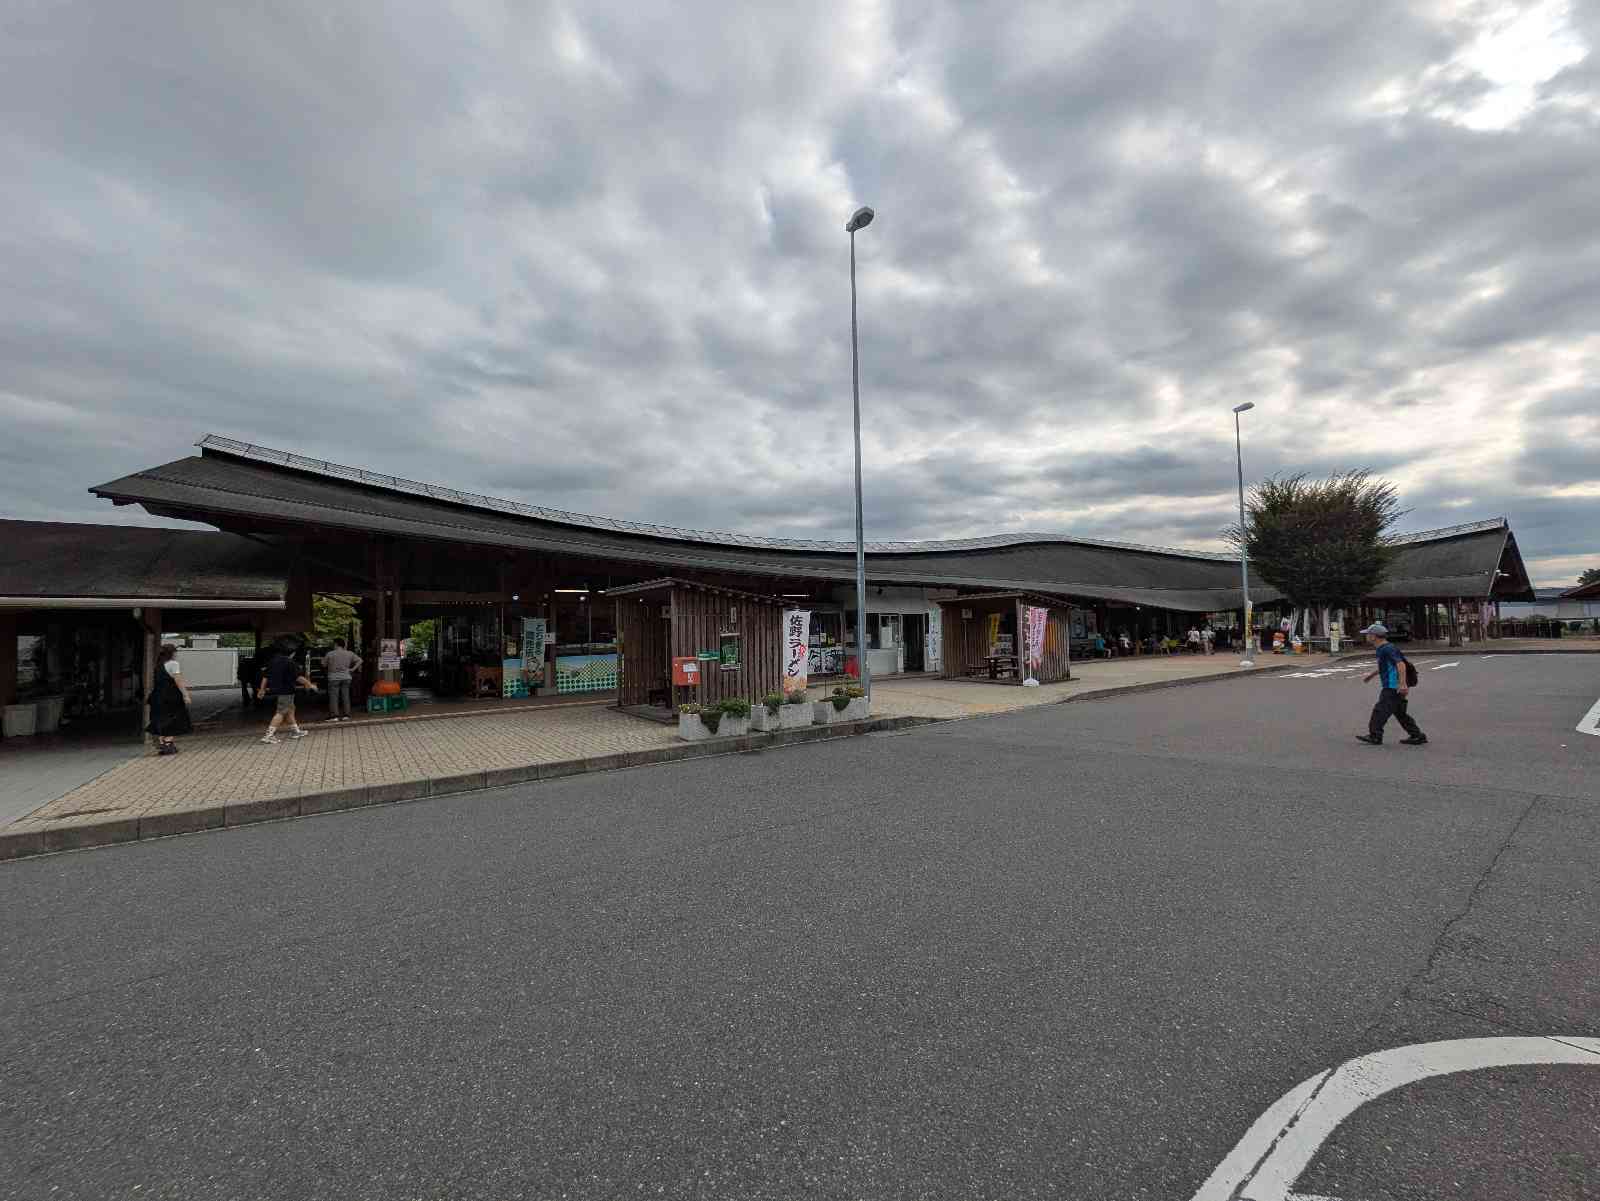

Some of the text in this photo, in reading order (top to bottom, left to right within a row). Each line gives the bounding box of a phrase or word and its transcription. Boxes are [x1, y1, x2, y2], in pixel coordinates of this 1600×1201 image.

[788, 615, 803, 677] 佐野ラーメン
